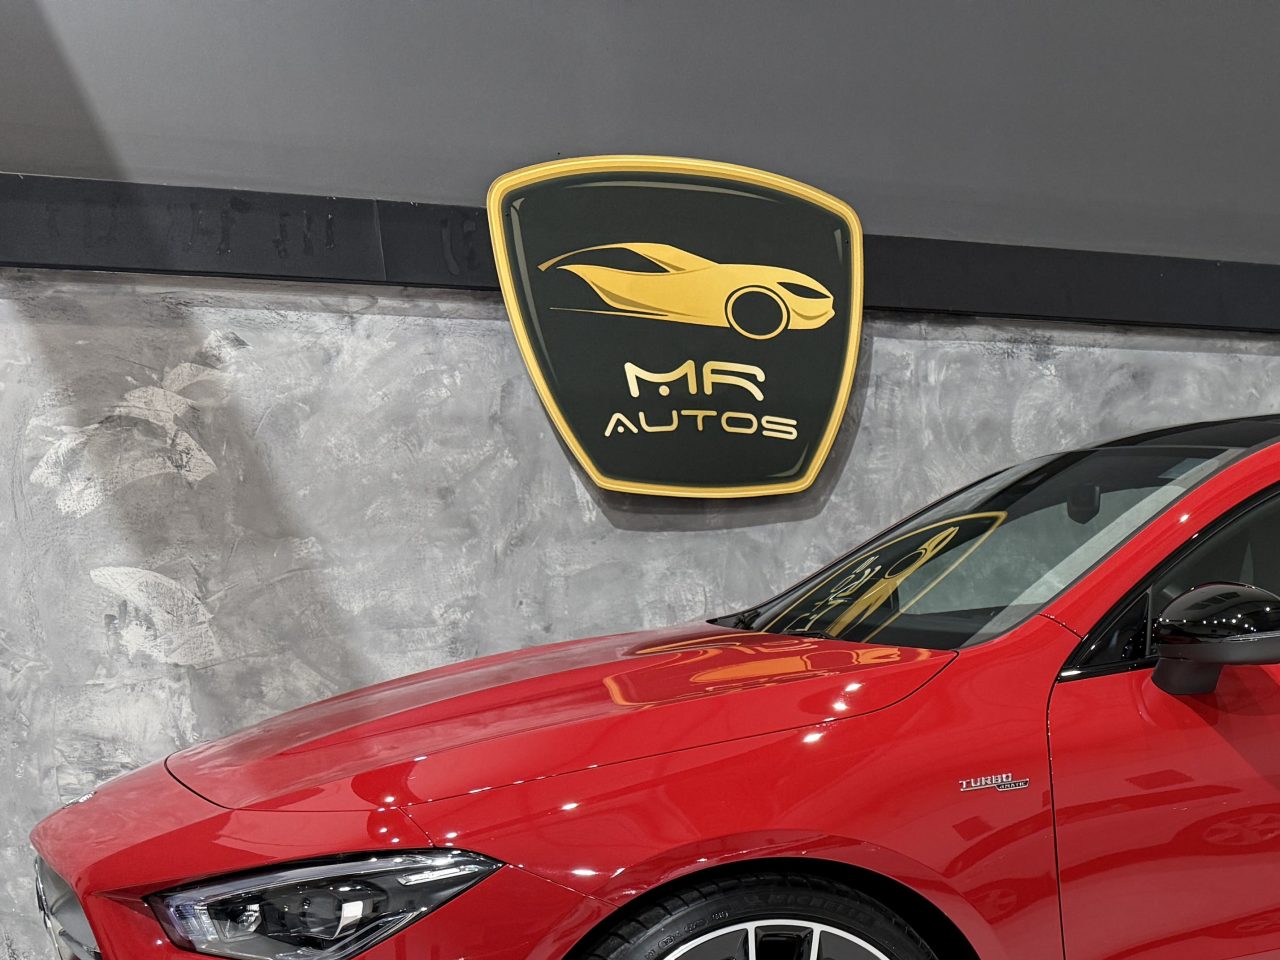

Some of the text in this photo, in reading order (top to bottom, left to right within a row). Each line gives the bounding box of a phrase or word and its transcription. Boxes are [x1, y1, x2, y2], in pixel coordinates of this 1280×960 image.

[623, 359, 766, 402] MR
[604, 409, 798, 440] AUTOS
[958, 773, 1012, 789] TURBO
